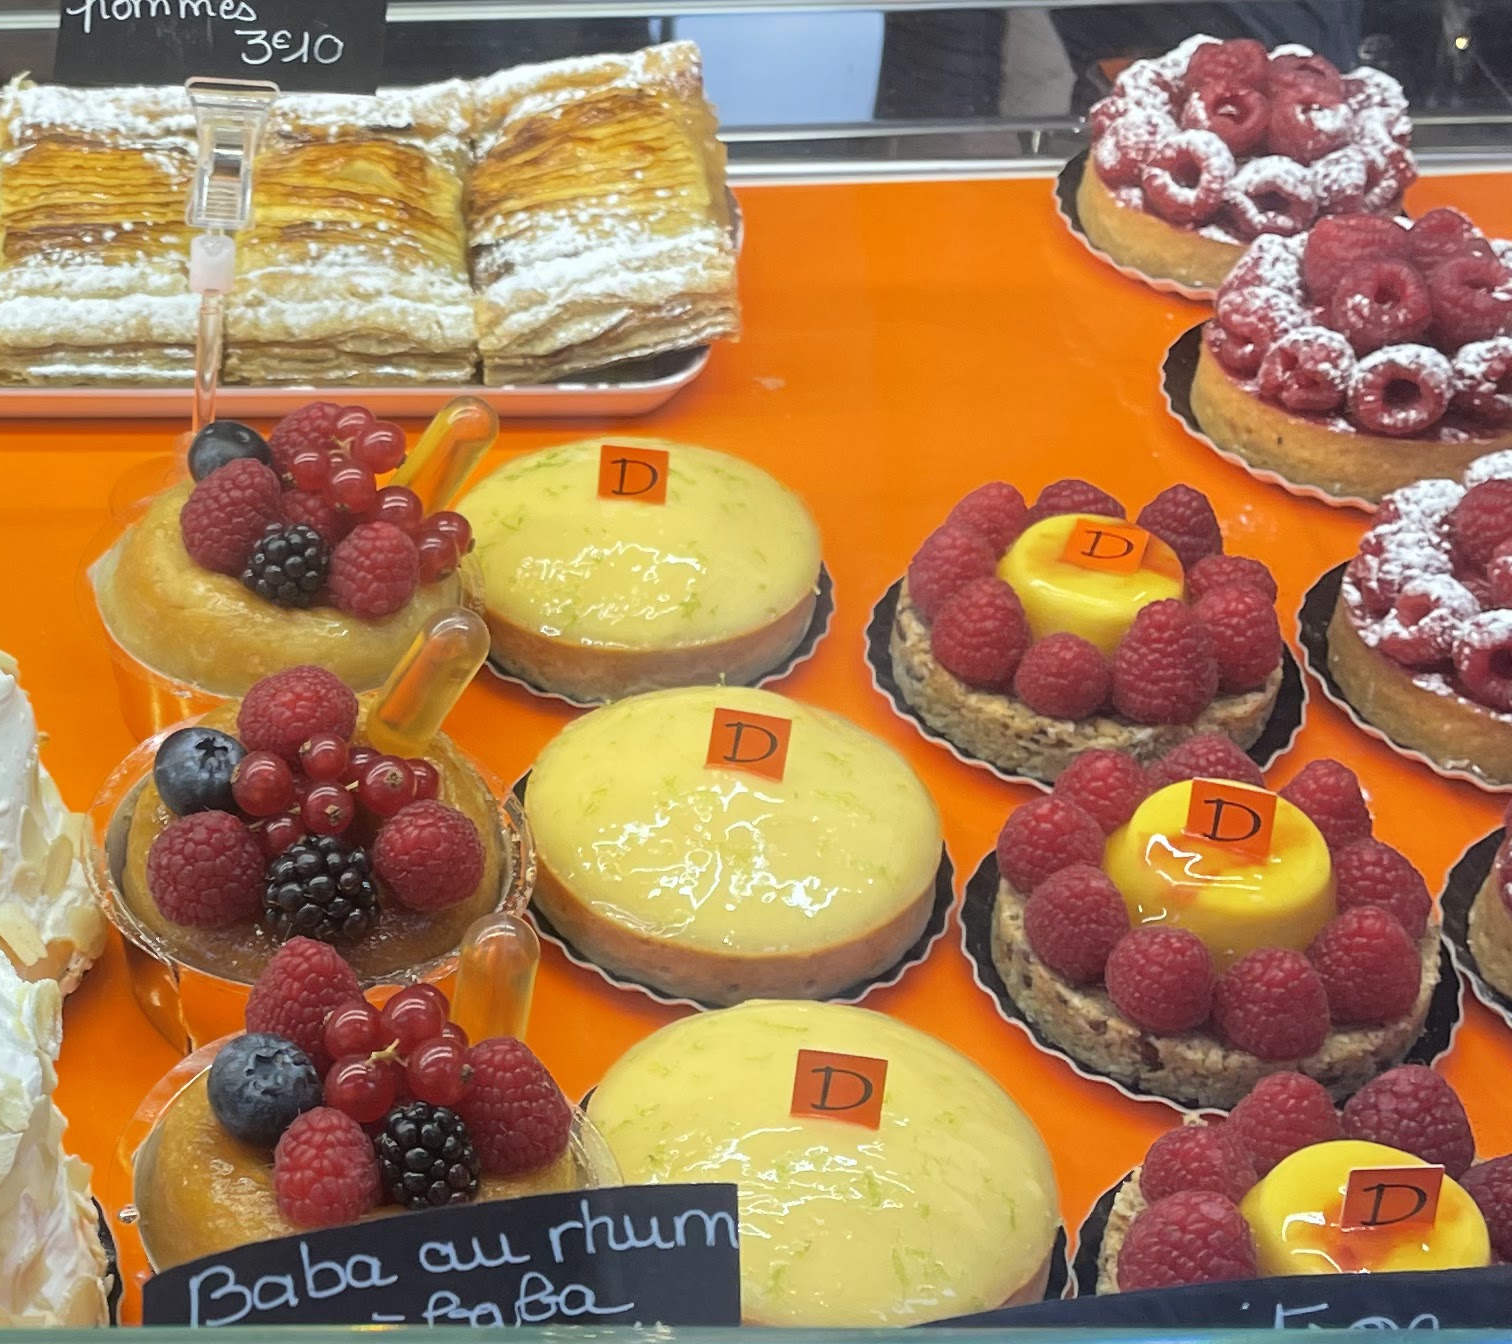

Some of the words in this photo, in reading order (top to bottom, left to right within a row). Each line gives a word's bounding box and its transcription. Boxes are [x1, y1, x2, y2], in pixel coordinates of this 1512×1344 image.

[611, 458, 659, 496] D
[1080, 528, 1136, 561] D
[725, 721, 779, 763] D
[1203, 797, 1263, 843] D
[812, 1066, 874, 1111] D
[1360, 1182, 1428, 1226] D
[188, 1241, 397, 1328] Baba
[419, 1231, 530, 1270] au
[549, 1199, 738, 1263] rhum
